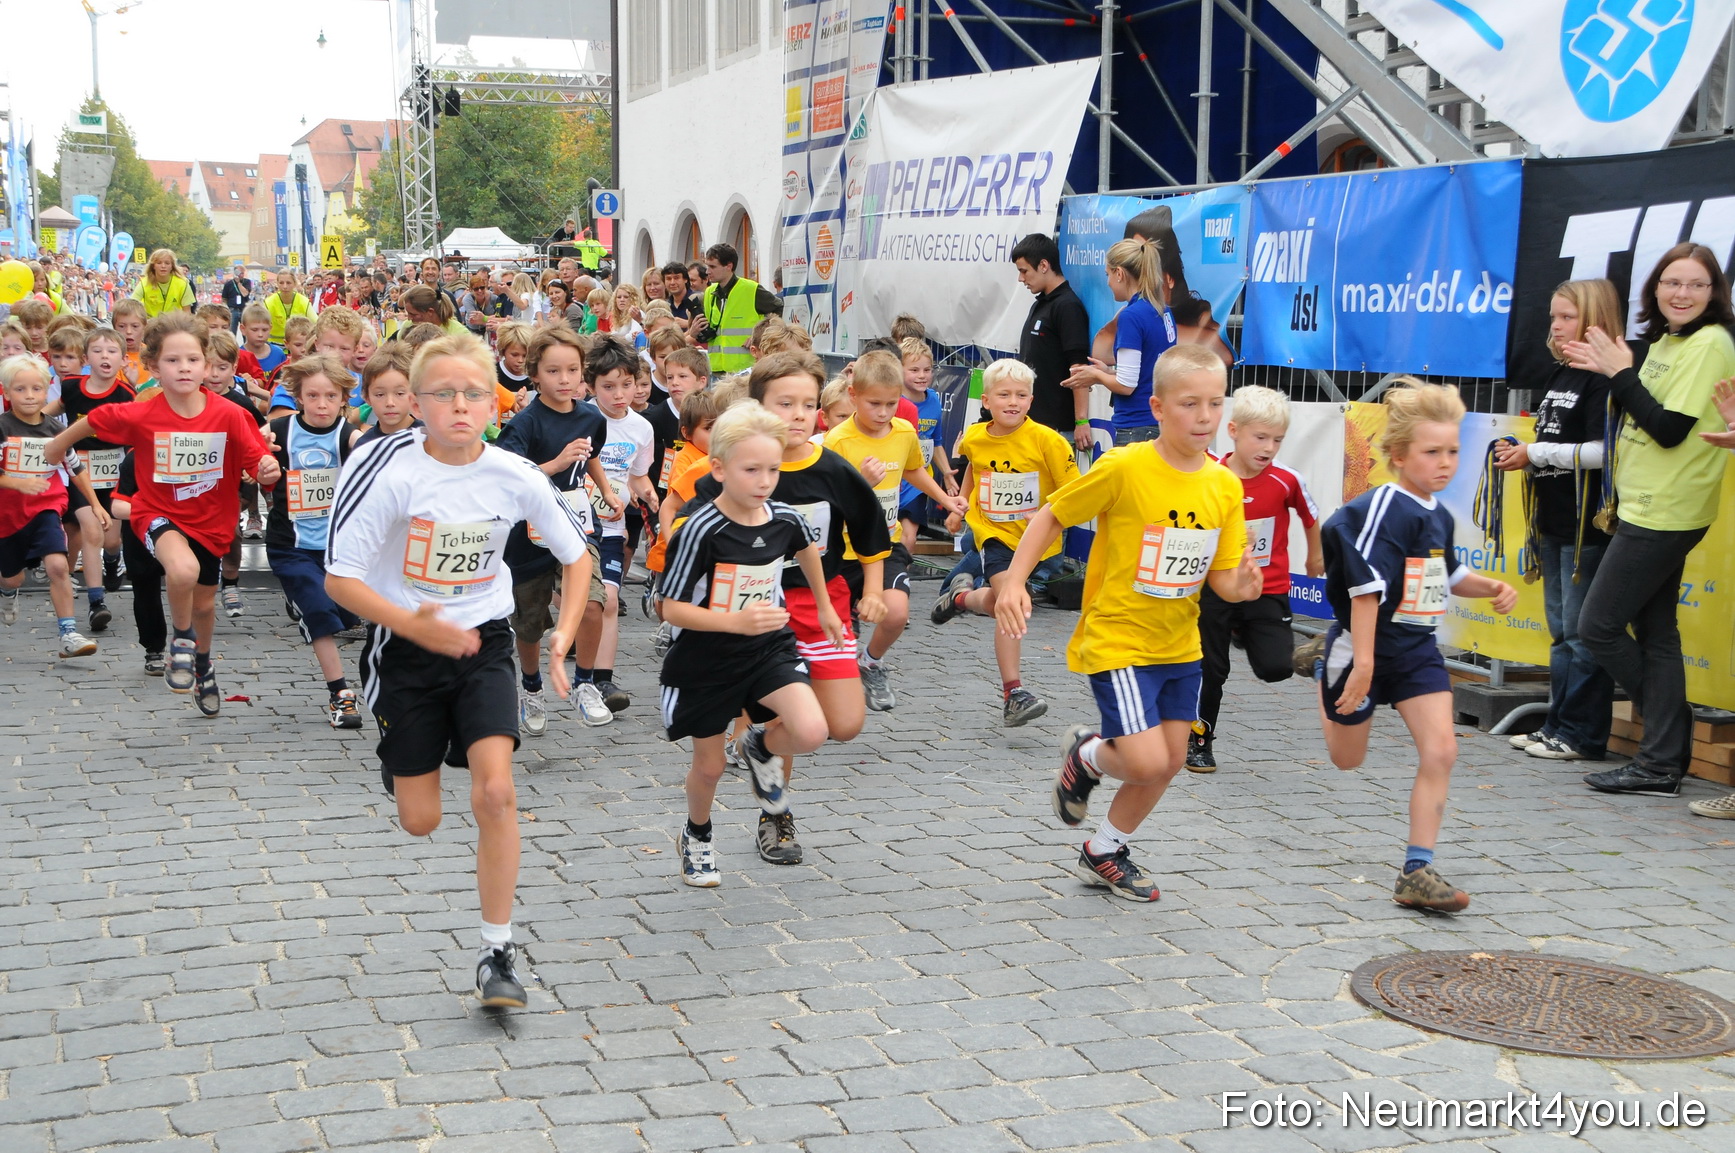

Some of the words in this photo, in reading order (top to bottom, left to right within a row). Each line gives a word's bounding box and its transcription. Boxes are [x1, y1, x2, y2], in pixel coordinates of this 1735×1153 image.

[888, 151, 1054, 219] PFLEIDERER
[1080, 211, 1108, 234] surfen.
[1204, 213, 1233, 238] maxi
[326, 245, 339, 261] A
[879, 233, 1027, 262] AKTIENGESELLSCHA
[1221, 237, 1235, 254] dsl
[1252, 217, 1316, 284] maxi
[1341, 269, 1513, 315] maxi-dsl.de
[1290, 285, 1318, 332] dsl
[24, 441, 46, 450] Marc
[174, 436, 204, 447] Fabian
[24, 455, 49, 467] 714
[157, 451, 166, 459] K4
[175, 450, 218, 467] 7036
[93, 464, 118, 475] 702
[303, 473, 330, 483] Stefan
[991, 479, 1025, 490] JUSTUS
[305, 487, 335, 502] 709
[994, 491, 1034, 506] 7294
[440, 531, 491, 548] Tobias
[436, 550, 496, 573] 7287
[1165, 556, 1209, 576] 7295
[1452, 542, 1506, 574] mein
[1455, 605, 1495, 626] Palisaden
[1506, 615, 1542, 632] Stufen
